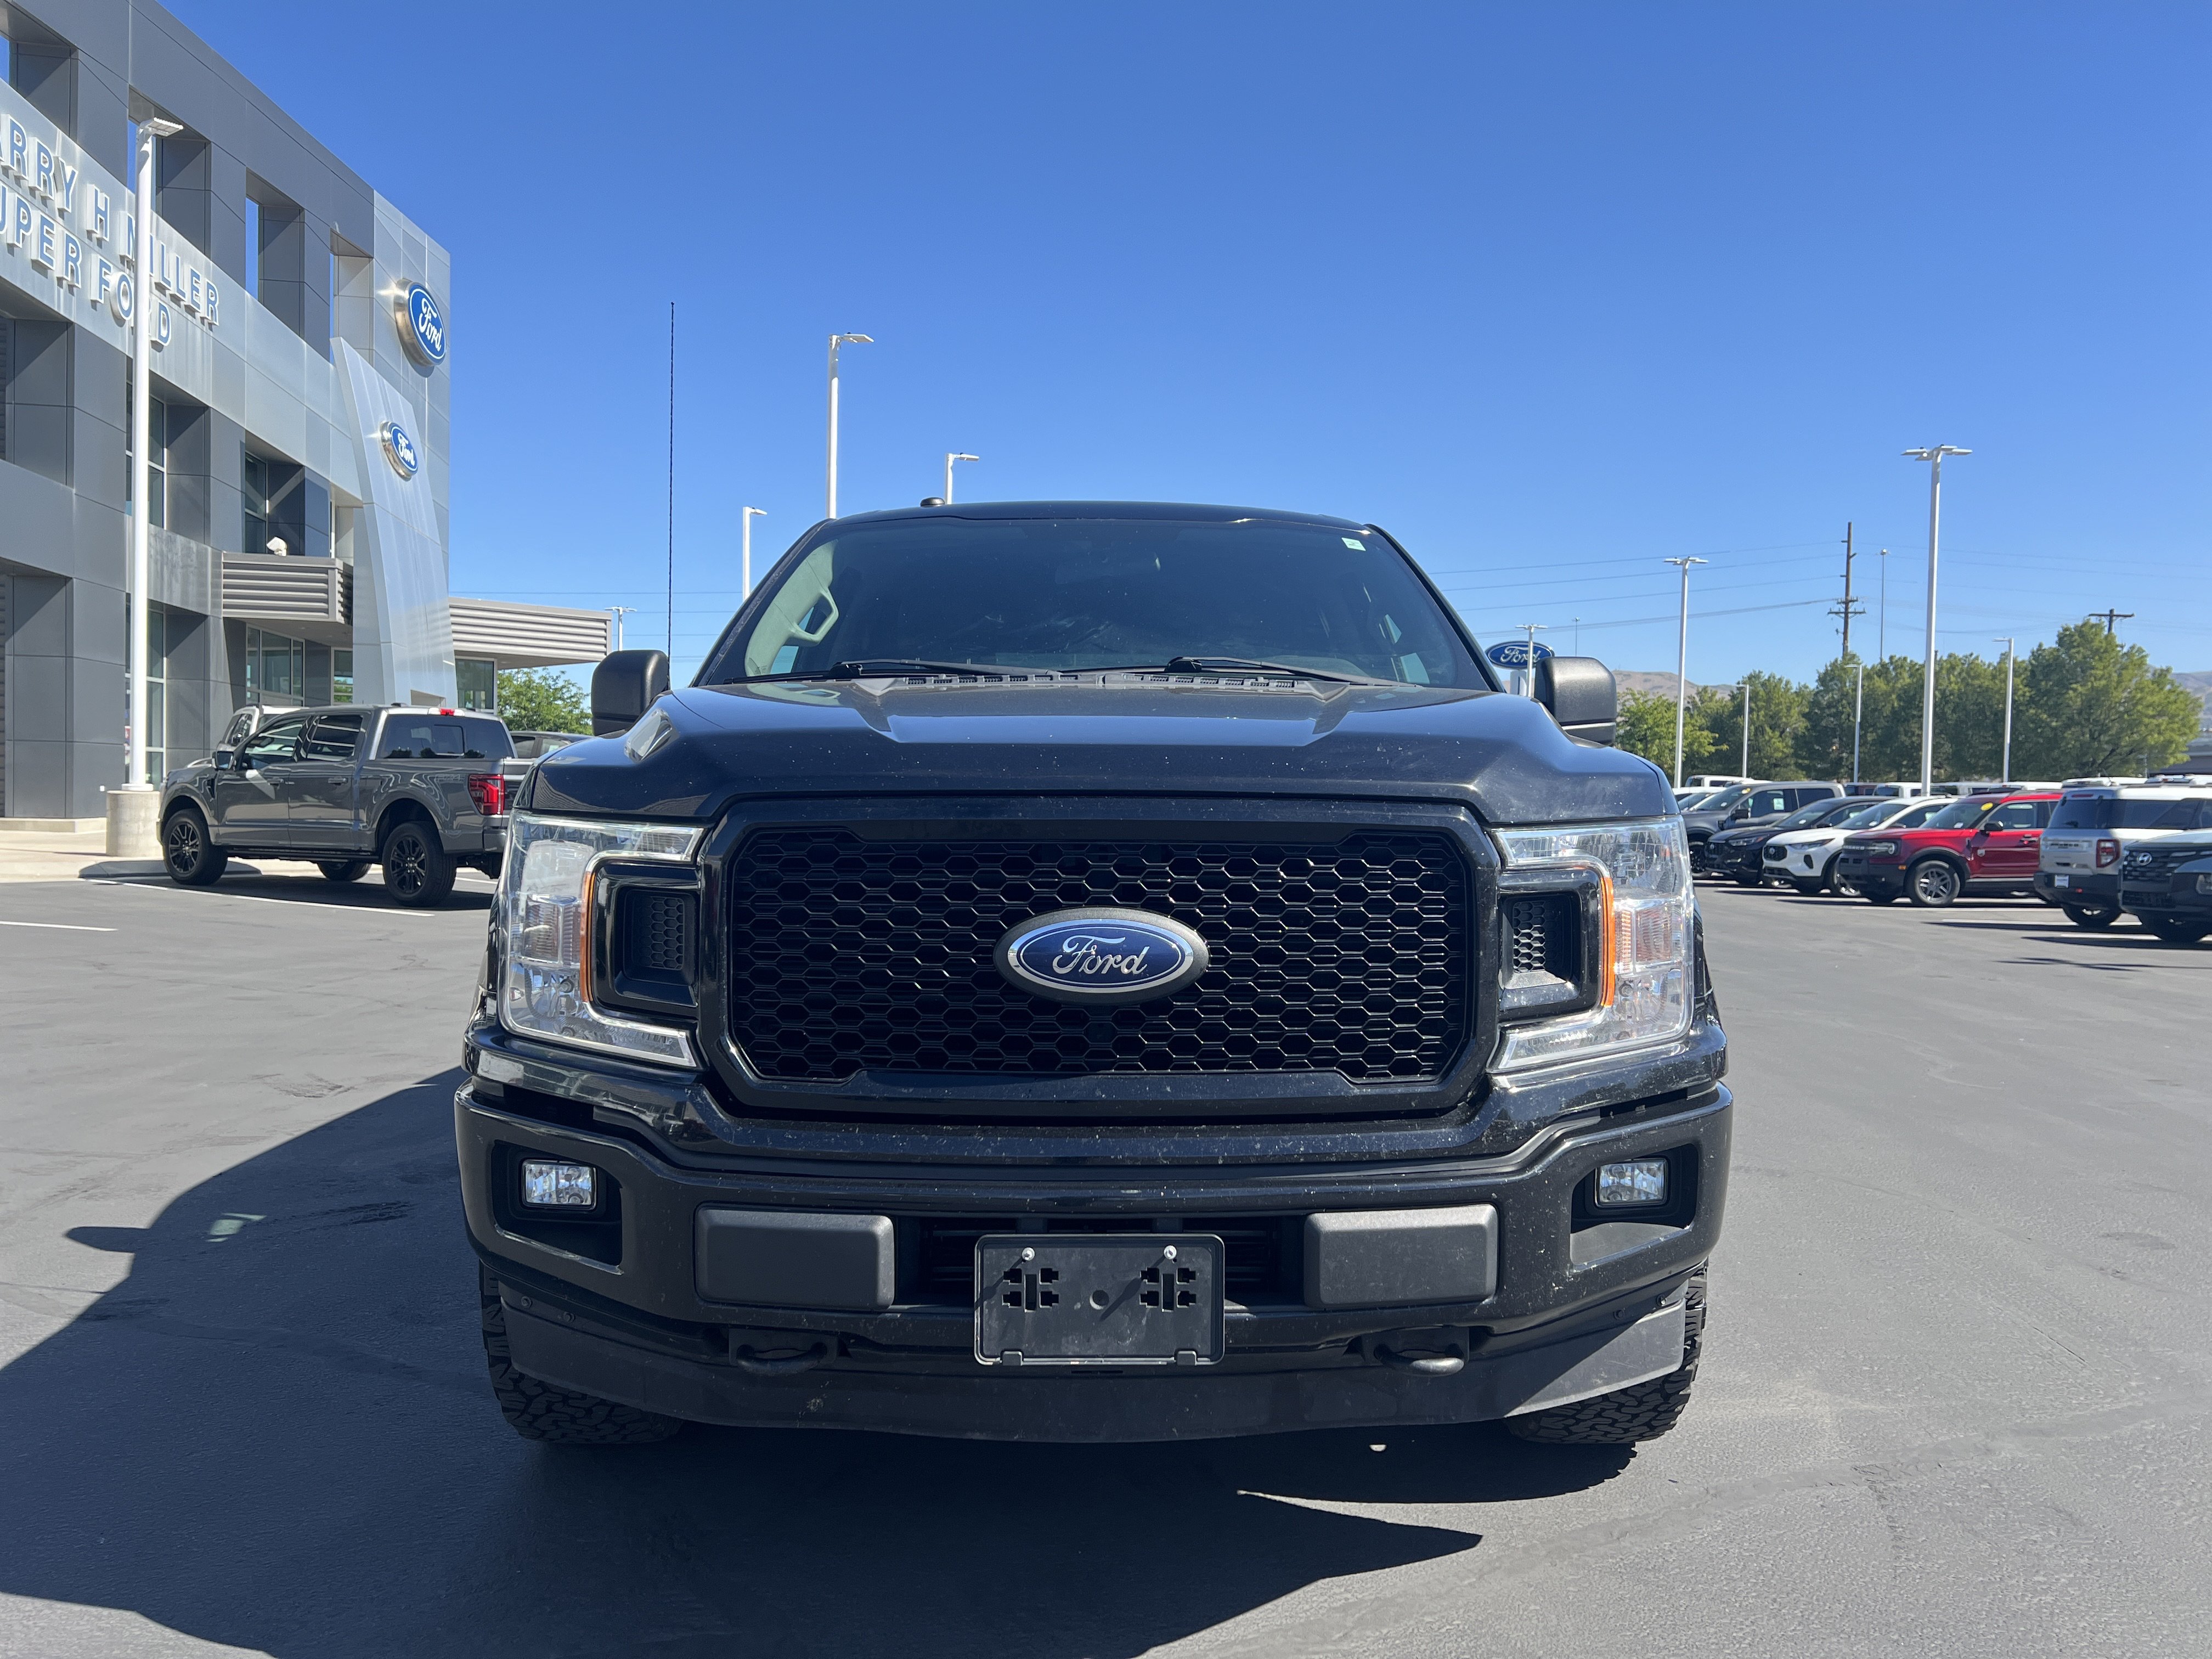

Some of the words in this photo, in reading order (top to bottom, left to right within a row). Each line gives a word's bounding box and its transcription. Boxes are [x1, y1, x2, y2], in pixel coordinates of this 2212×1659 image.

[0, 116, 78, 213] RRY
[94, 184, 110, 242] H
[98, 255, 172, 347] FOD
[419, 297, 442, 352] Ford
[398, 432, 415, 466] Ford
[1500, 646, 1541, 663] Ford
[1052, 935, 1150, 974] Ford
